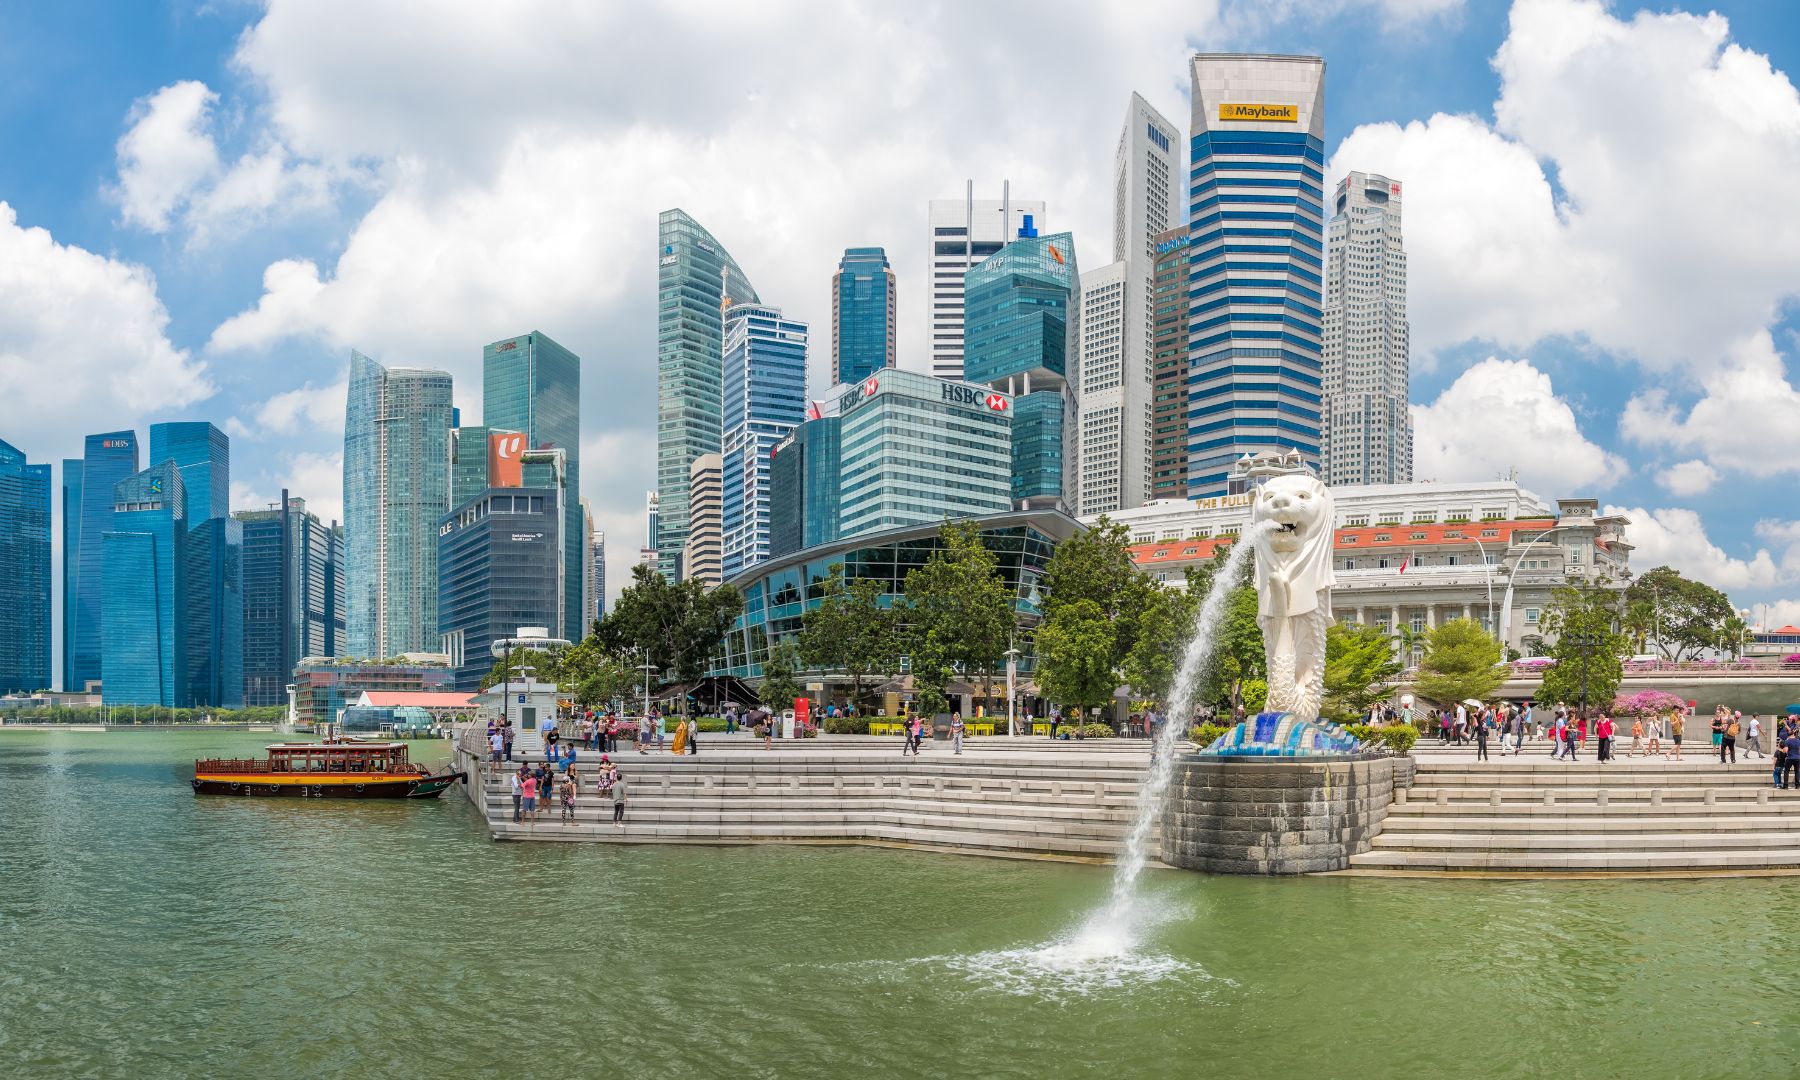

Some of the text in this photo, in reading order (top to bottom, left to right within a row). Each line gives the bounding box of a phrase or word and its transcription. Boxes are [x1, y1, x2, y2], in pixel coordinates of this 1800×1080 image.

[1235, 106, 1291, 119] Maybank
[660, 255, 677, 266] ANZ
[985, 257, 1004, 273] MYP
[839, 384, 865, 412] HSBC
[941, 383, 985, 406] HSBC
[111, 440, 129, 448] DBS
[1196, 498, 1217, 510] THE
